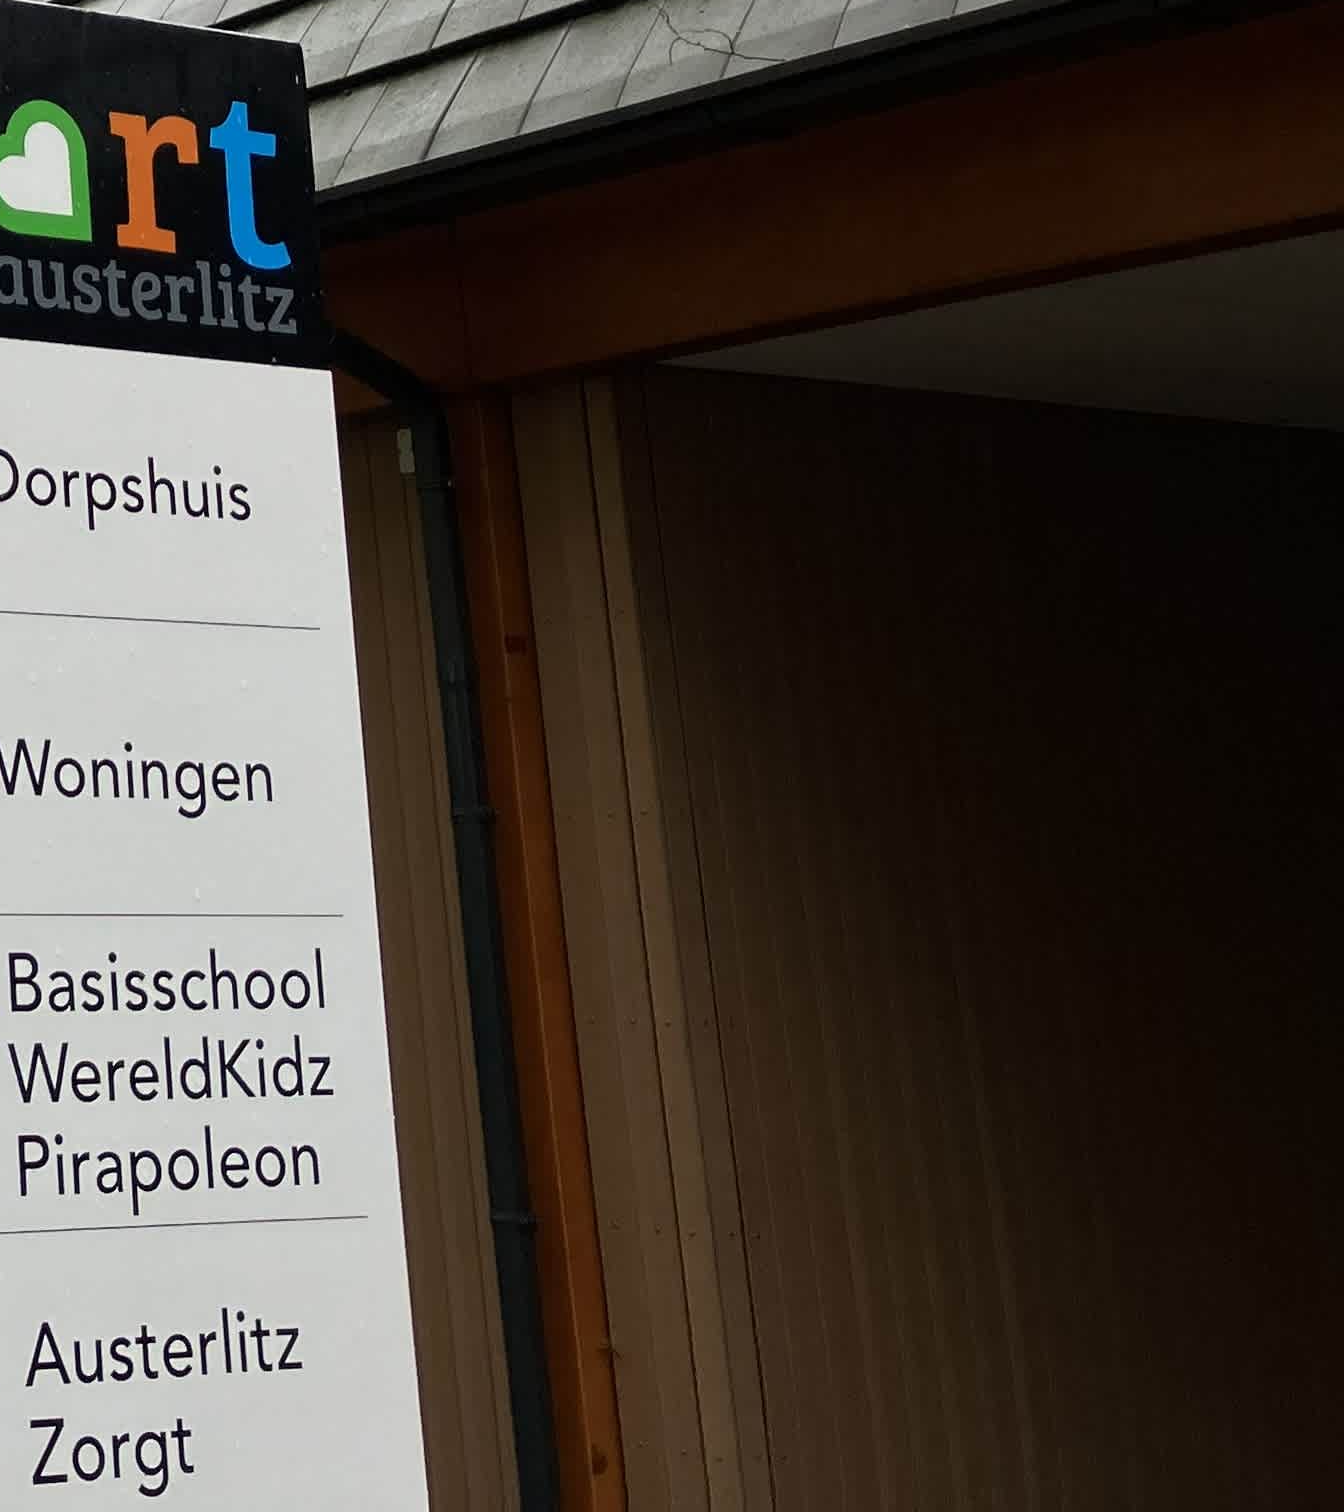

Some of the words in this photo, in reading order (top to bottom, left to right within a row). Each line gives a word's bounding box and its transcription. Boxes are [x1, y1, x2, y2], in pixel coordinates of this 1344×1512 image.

[7, 947, 326, 1014] Basisschool
[7, 1034, 335, 1105] WereldKidz
[16, 1124, 321, 1217] Pirapoleon
[25, 1307, 304, 1388] Austerlitz
[29, 1417, 196, 1498] Zorgt
